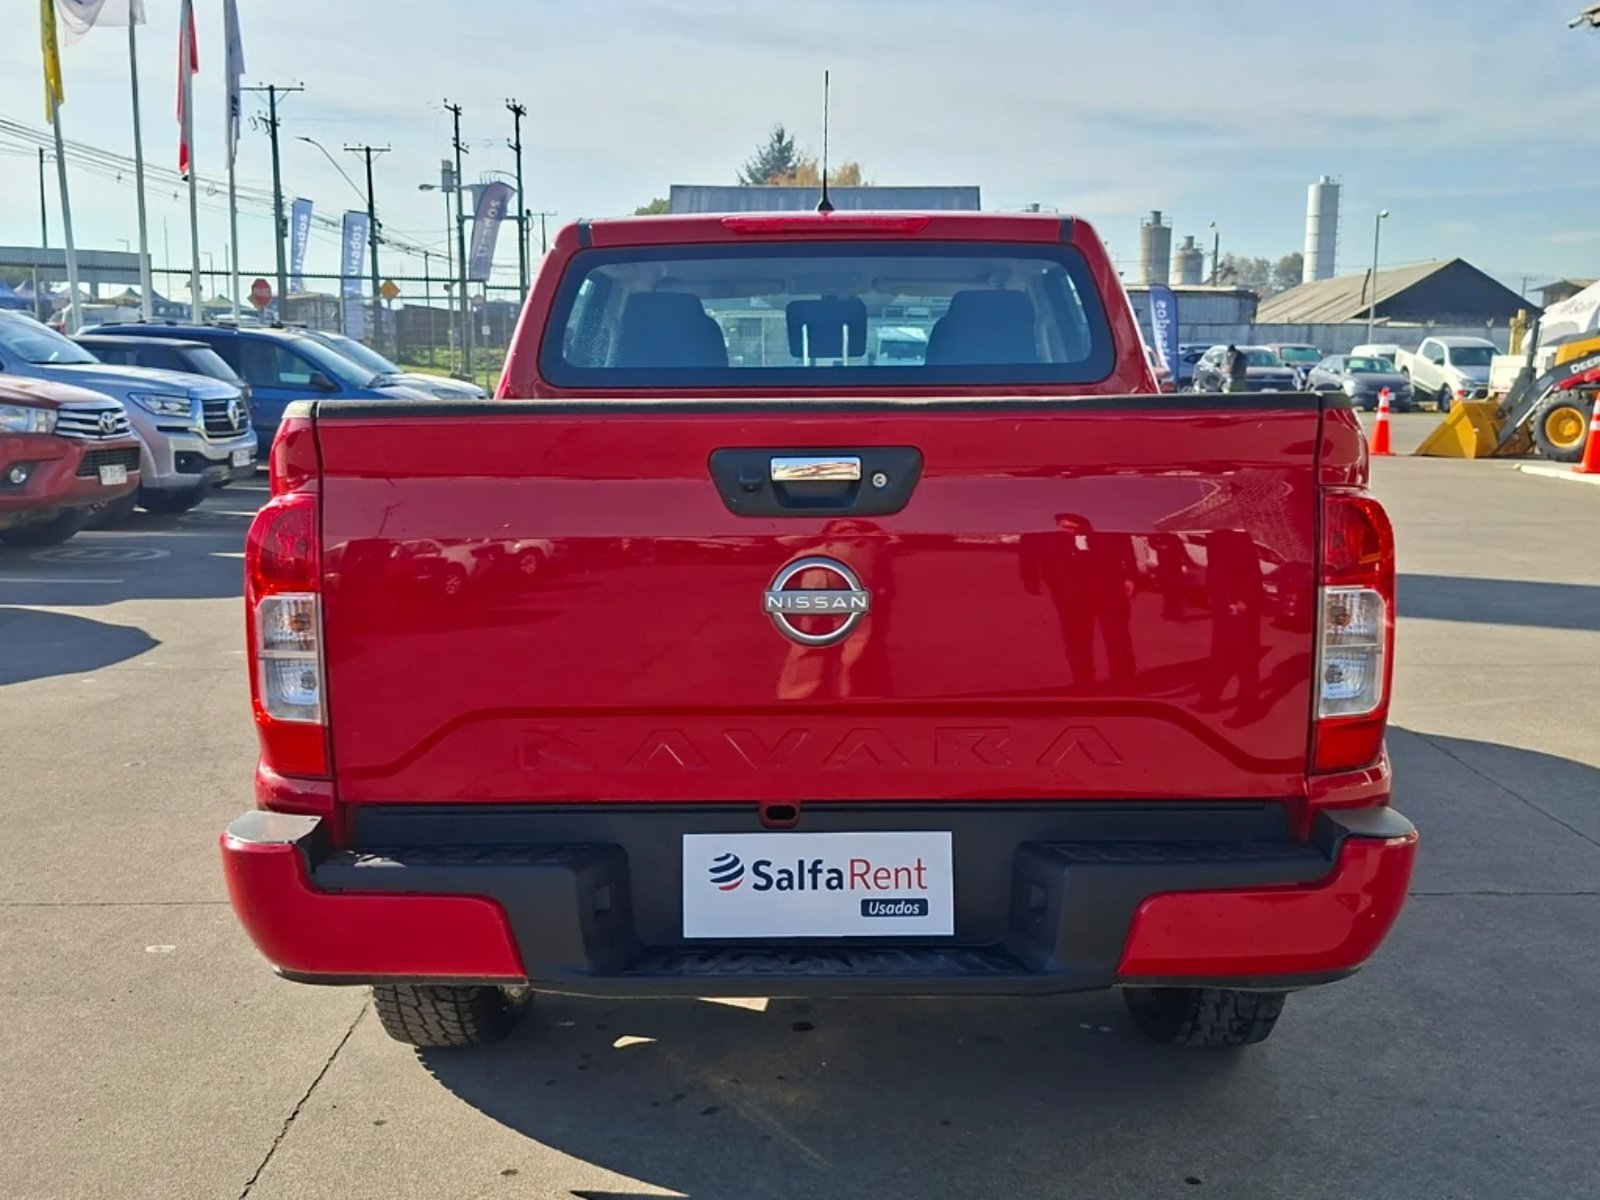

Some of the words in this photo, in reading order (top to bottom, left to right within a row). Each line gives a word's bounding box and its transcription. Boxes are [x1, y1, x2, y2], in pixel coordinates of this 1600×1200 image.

[348, 224, 362, 275] Usados
[767, 596, 867, 609] NISSAN
[517, 726, 1124, 769] NAVARA
[751, 857, 928, 891] SalfaRent
[868, 901, 920, 915] Usados
